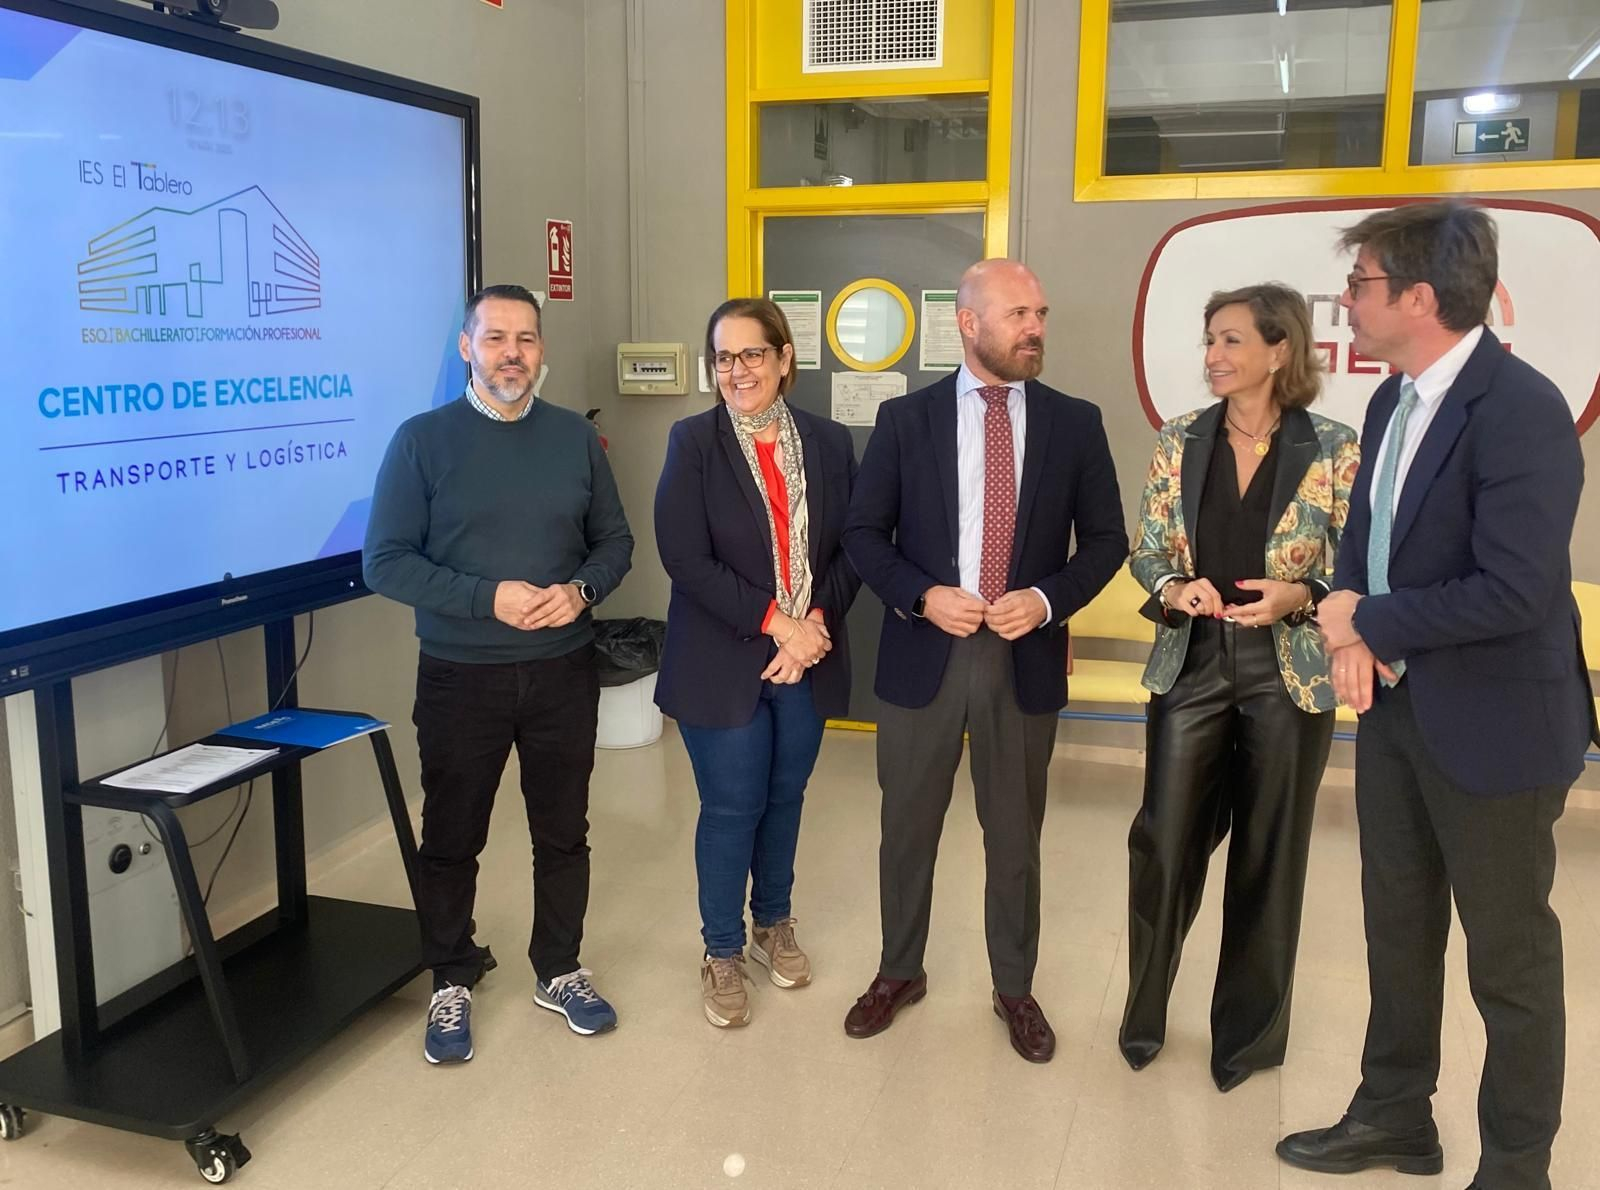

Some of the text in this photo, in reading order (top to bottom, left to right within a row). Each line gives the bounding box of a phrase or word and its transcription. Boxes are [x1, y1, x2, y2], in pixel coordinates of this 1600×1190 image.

[79, 159, 193, 195] IES El Tablero
[115, 327, 194, 343] BACHILLERATO
[201, 325, 261, 341] FORMACIÓN
[263, 327, 322, 341] PROFESIONAL
[38, 374, 353, 419] CENTRO DE EXCELENCIA
[56, 439, 347, 494] TRANSPORTE Y LOGÍSTICA
